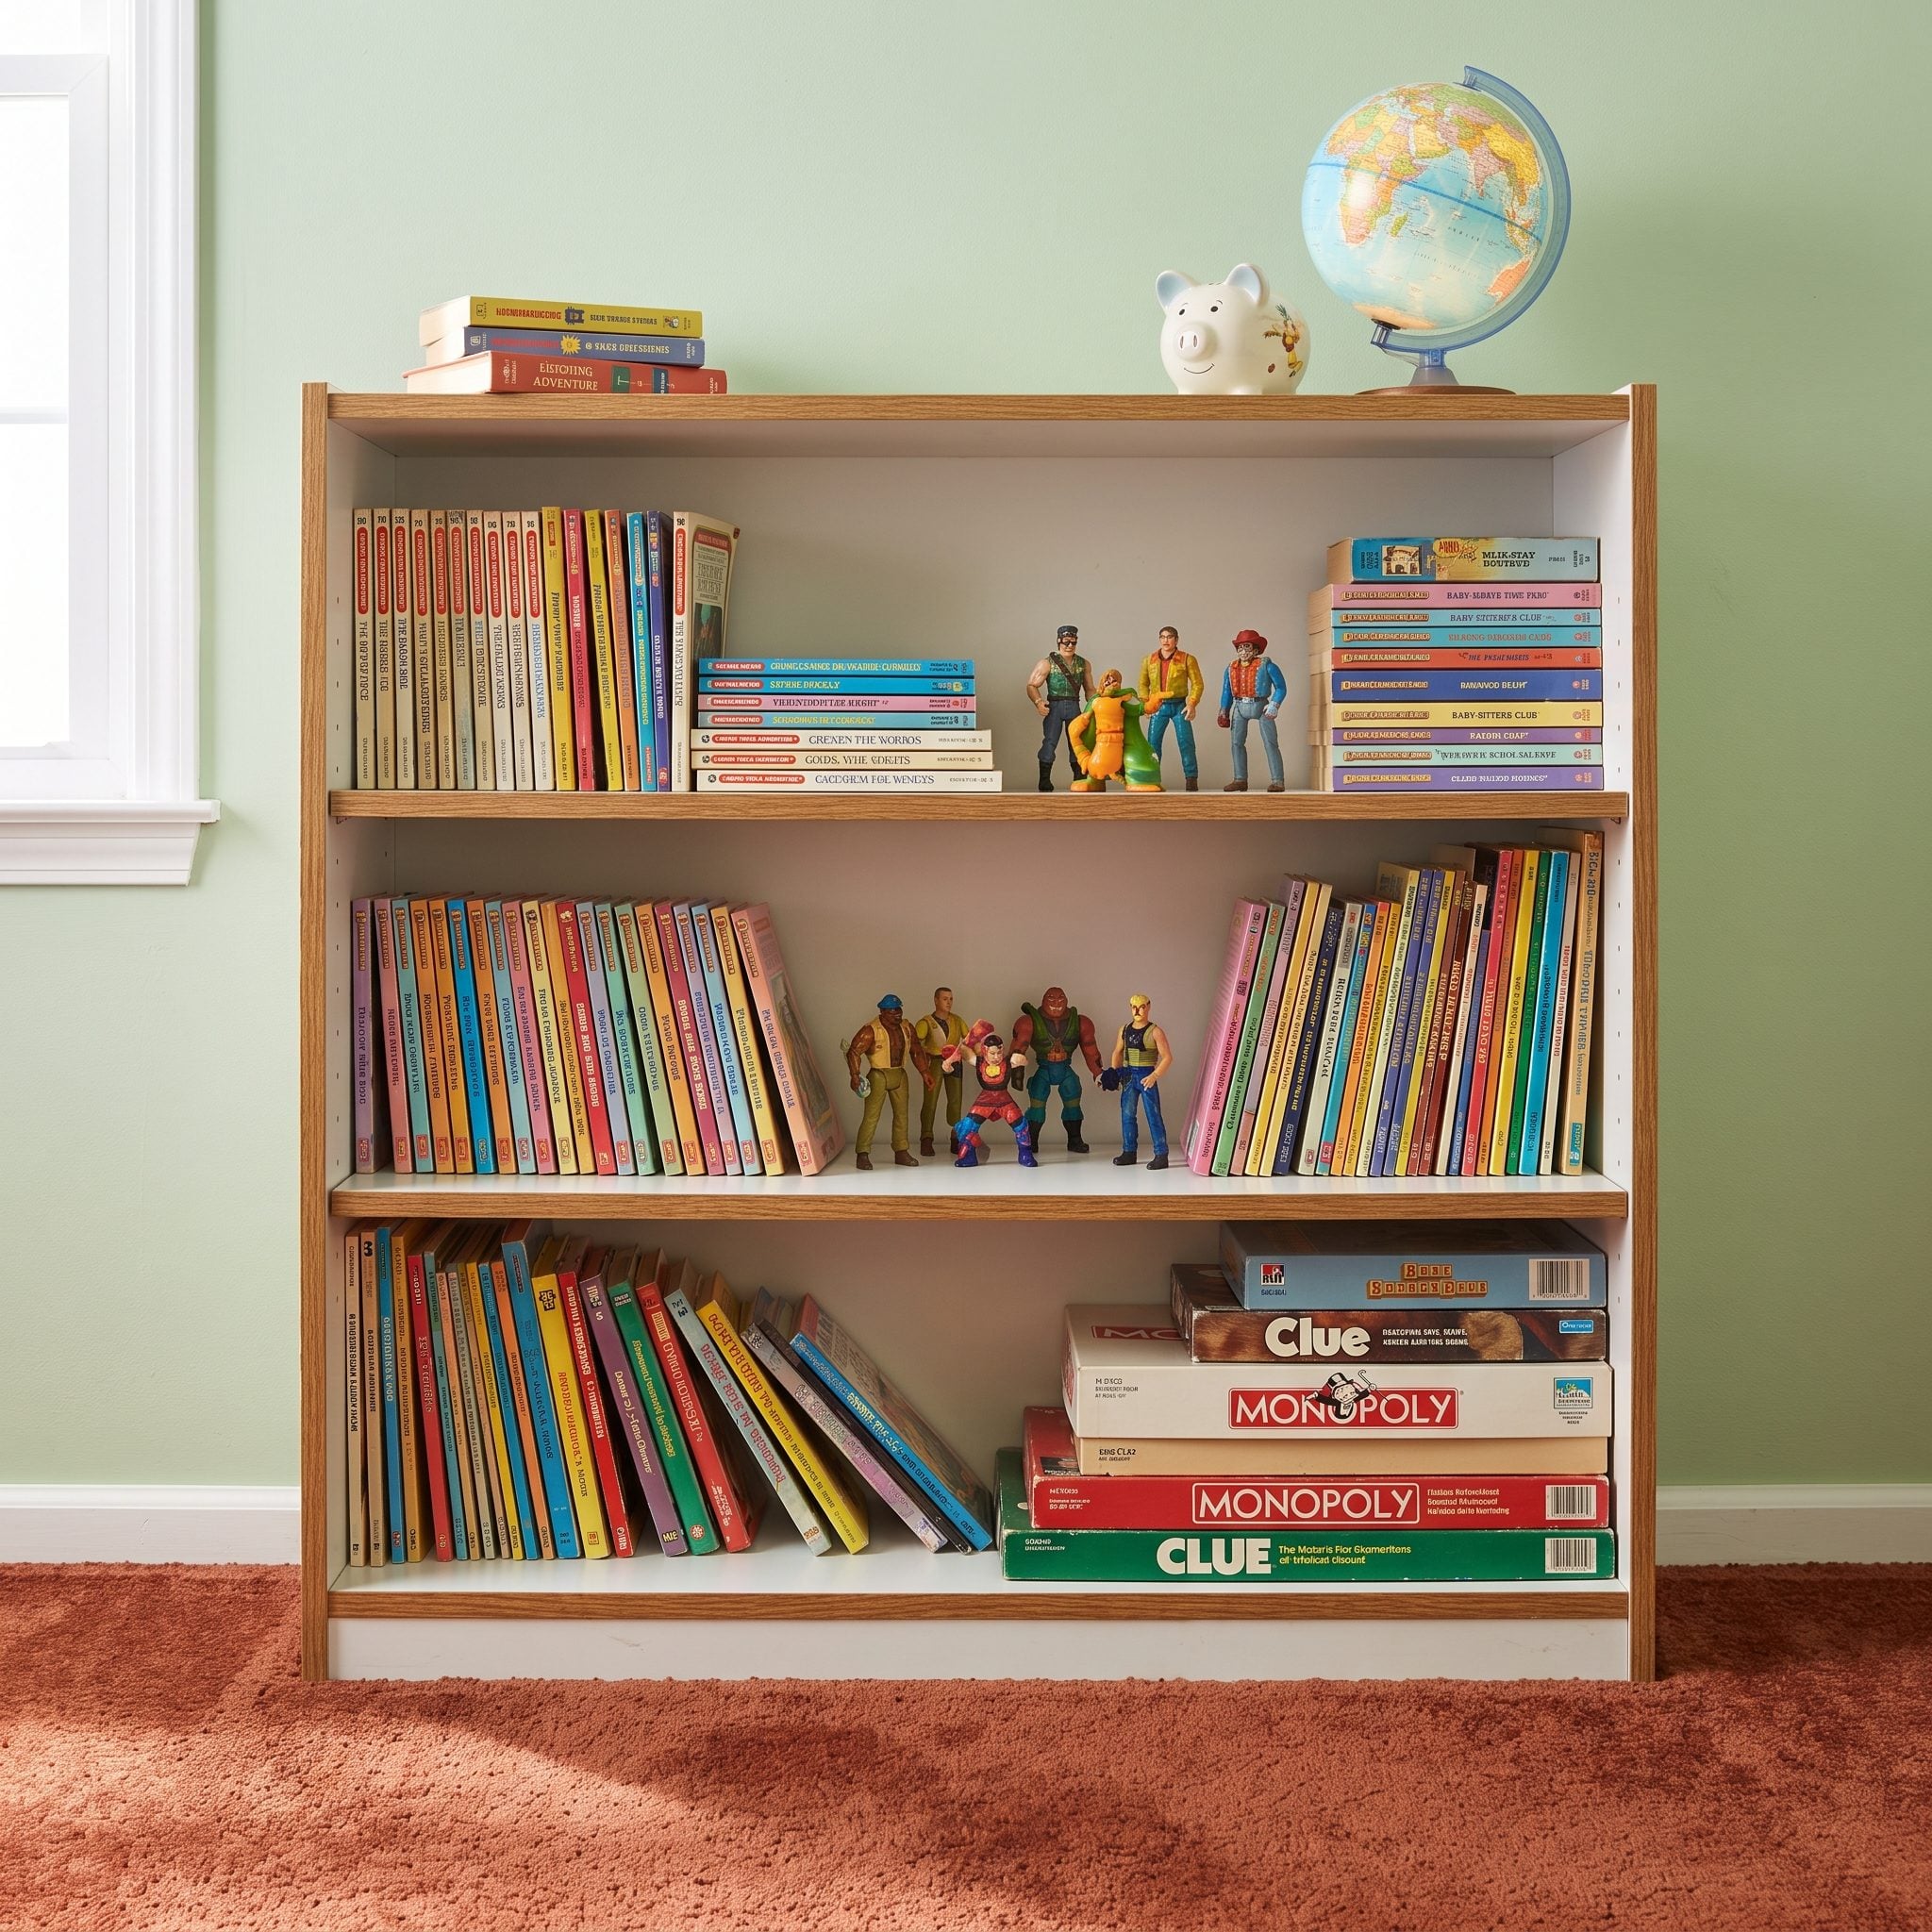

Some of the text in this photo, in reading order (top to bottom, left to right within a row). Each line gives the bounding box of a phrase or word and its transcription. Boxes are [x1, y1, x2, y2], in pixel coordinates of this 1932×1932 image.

[1265, 1317, 1371, 1357] Clue
[1199, 1489, 1413, 1519] MONOPOLY
[1157, 1537, 1272, 1575] CLUE
[1278, 1545, 1296, 1554] The
